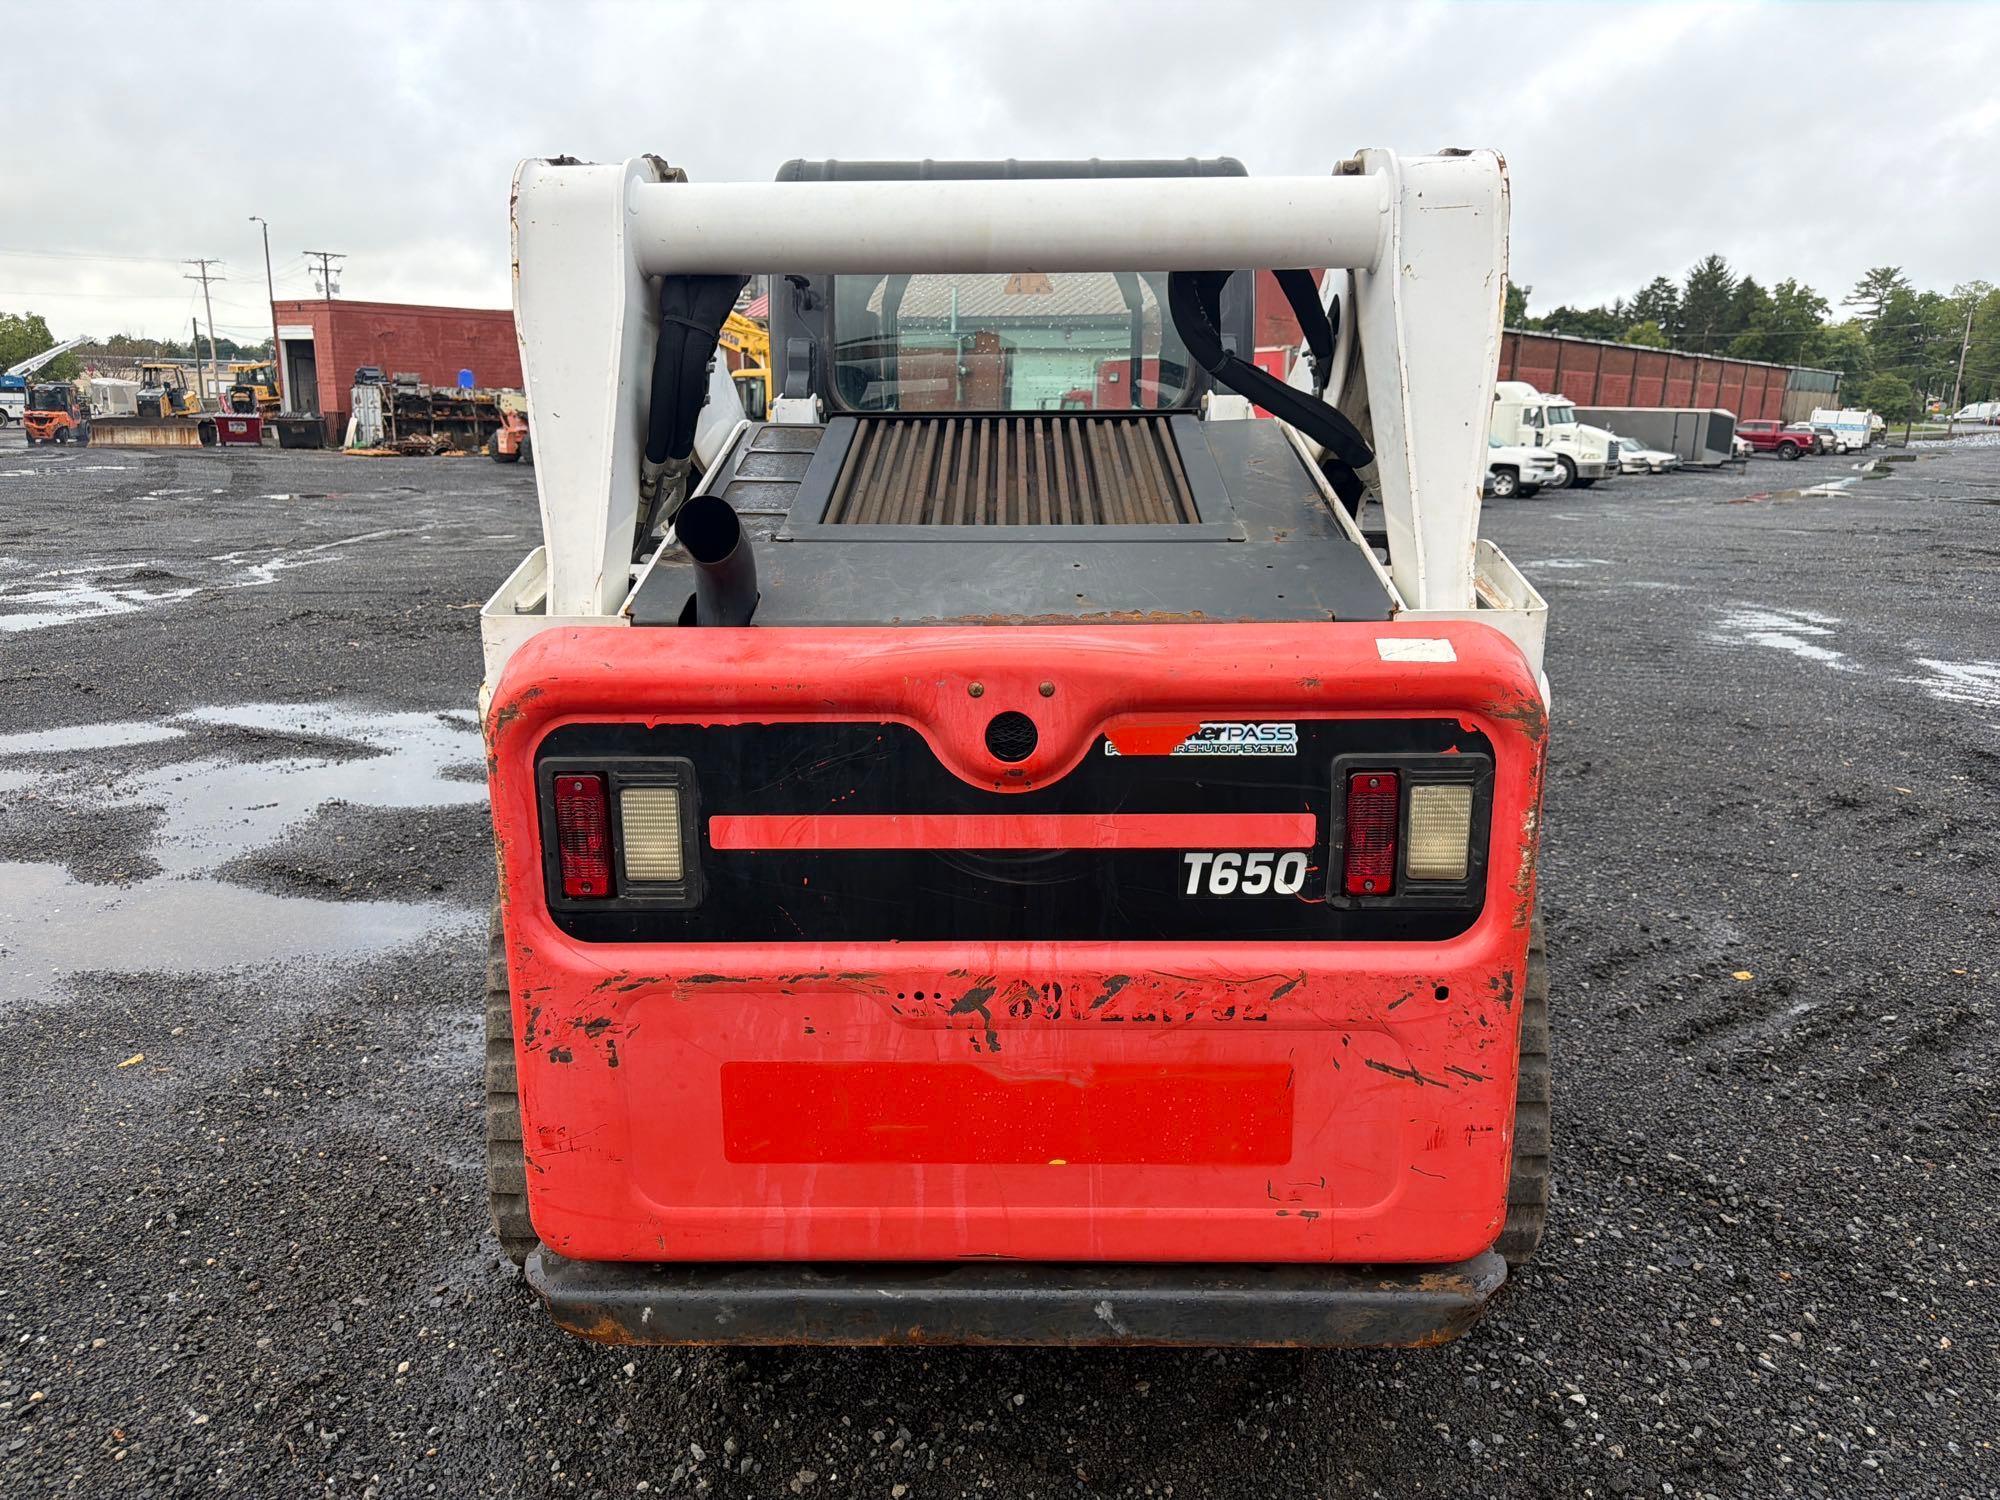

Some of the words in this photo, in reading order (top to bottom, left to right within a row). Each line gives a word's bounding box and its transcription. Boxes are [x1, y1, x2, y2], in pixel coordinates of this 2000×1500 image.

[1187, 743, 1243, 754] SHUTOFF
[1243, 743, 1295, 754] SYSTEM
[1184, 852, 1308, 895] T650
